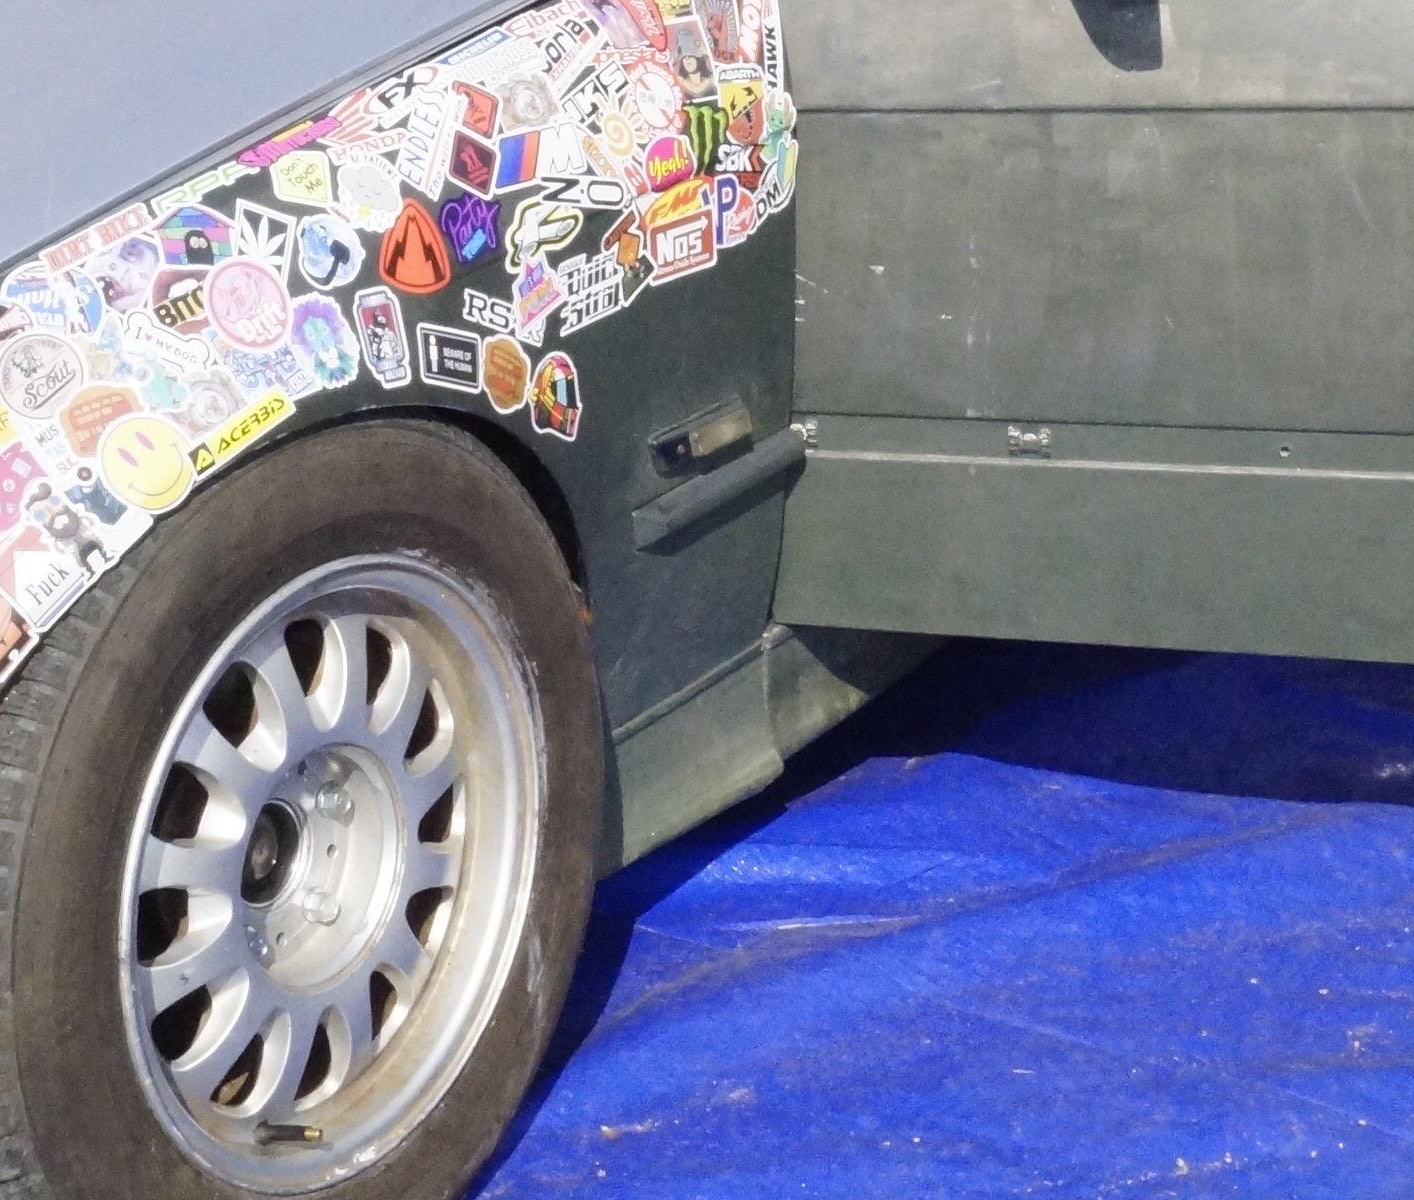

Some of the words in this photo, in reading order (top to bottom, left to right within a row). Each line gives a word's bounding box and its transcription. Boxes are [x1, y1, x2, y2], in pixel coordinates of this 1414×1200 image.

[505, 0, 581, 38] Eibach
[448, 32, 503, 65] MICHELIN
[542, 18, 585, 73] orla
[377, 71, 427, 110] FX
[719, 69, 761, 81] ABARTH
[333, 132, 406, 161] HONDA
[398, 86, 446, 187] ENDLESS
[287, 162, 318, 187] Touch
[716, 144, 752, 172] SBK
[305, 177, 323, 194] Me
[655, 229, 703, 266] NOS
[235, 301, 286, 344] Drift
[155, 338, 172, 353] MY
[173, 347, 198, 365] DOG
[22, 359, 77, 411] Scout
[24, 561, 72, 607] Fuck
